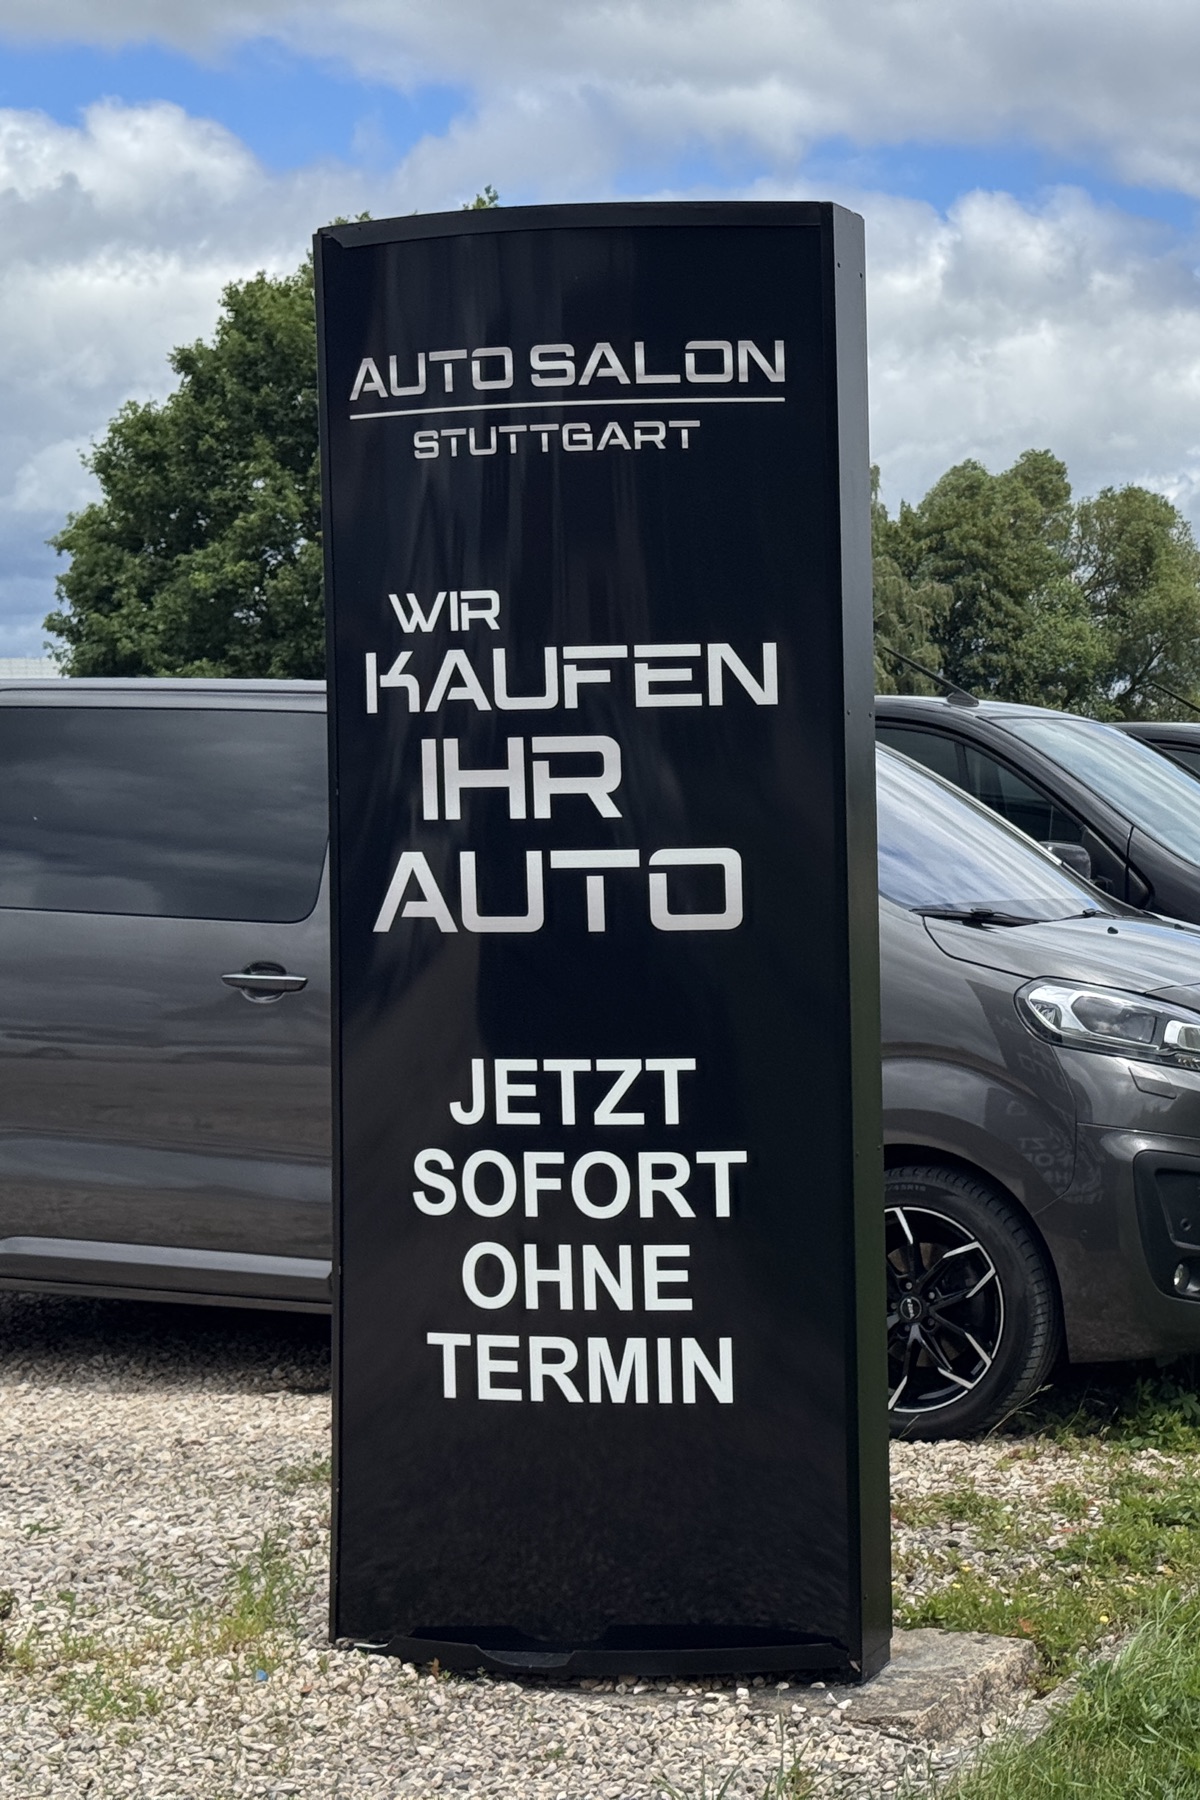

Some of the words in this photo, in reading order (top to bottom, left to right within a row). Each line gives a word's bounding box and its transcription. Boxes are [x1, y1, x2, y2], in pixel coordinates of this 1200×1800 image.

[349, 346, 513, 402] AUTO
[529, 340, 786, 388] SALON
[413, 420, 701, 460] STUTTGART
[388, 589, 501, 634] WIR
[365, 642, 779, 714] KAUFEN
[421, 735, 623, 821] IHR
[373, 847, 743, 933] AUTO
[449, 1057, 697, 1126] JETZT
[412, 1148, 748, 1220] SOFORT
[462, 1241, 693, 1311] OHNE
[426, 1332, 734, 1405] TERMIN
